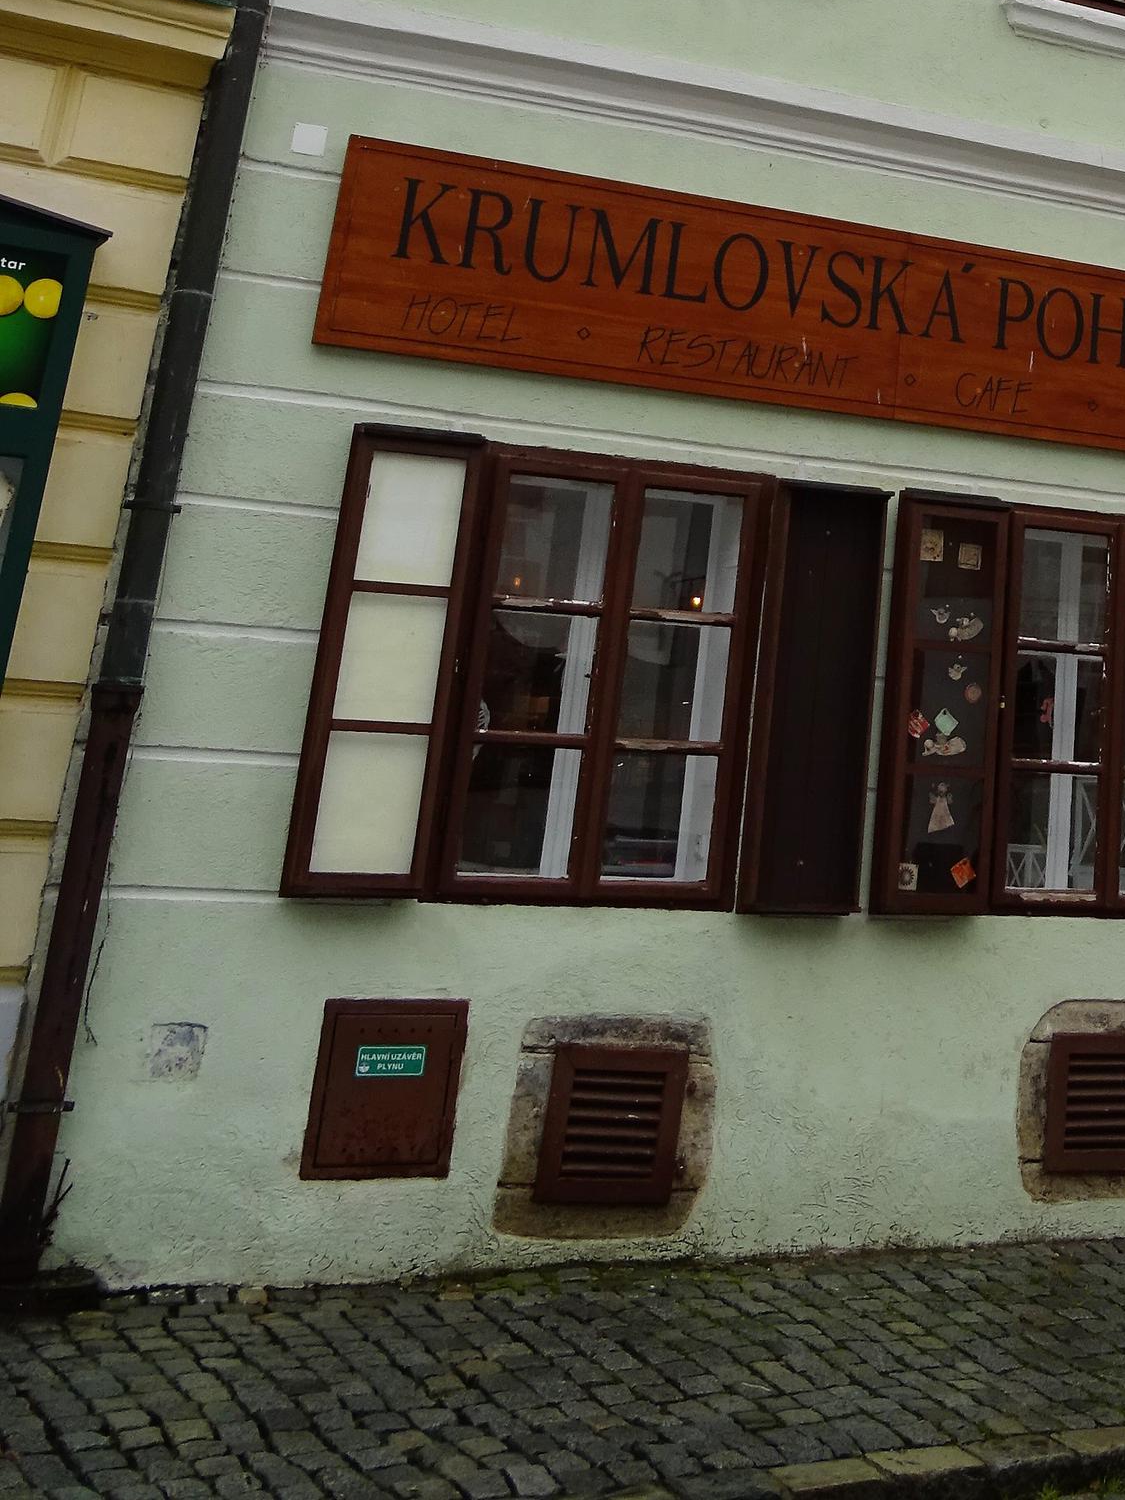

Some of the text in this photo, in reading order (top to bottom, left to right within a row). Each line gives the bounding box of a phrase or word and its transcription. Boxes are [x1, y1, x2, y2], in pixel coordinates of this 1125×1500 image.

[391, 177, 975, 343] KRUMLOVSKÁ
[401, 294, 523, 343] HOTEL
[636, 324, 860, 389] RESTAURANT
[955, 372, 1034, 414] CAFE
[361, 1051, 422, 1060] HLAVNÍ UZÁVĚR
